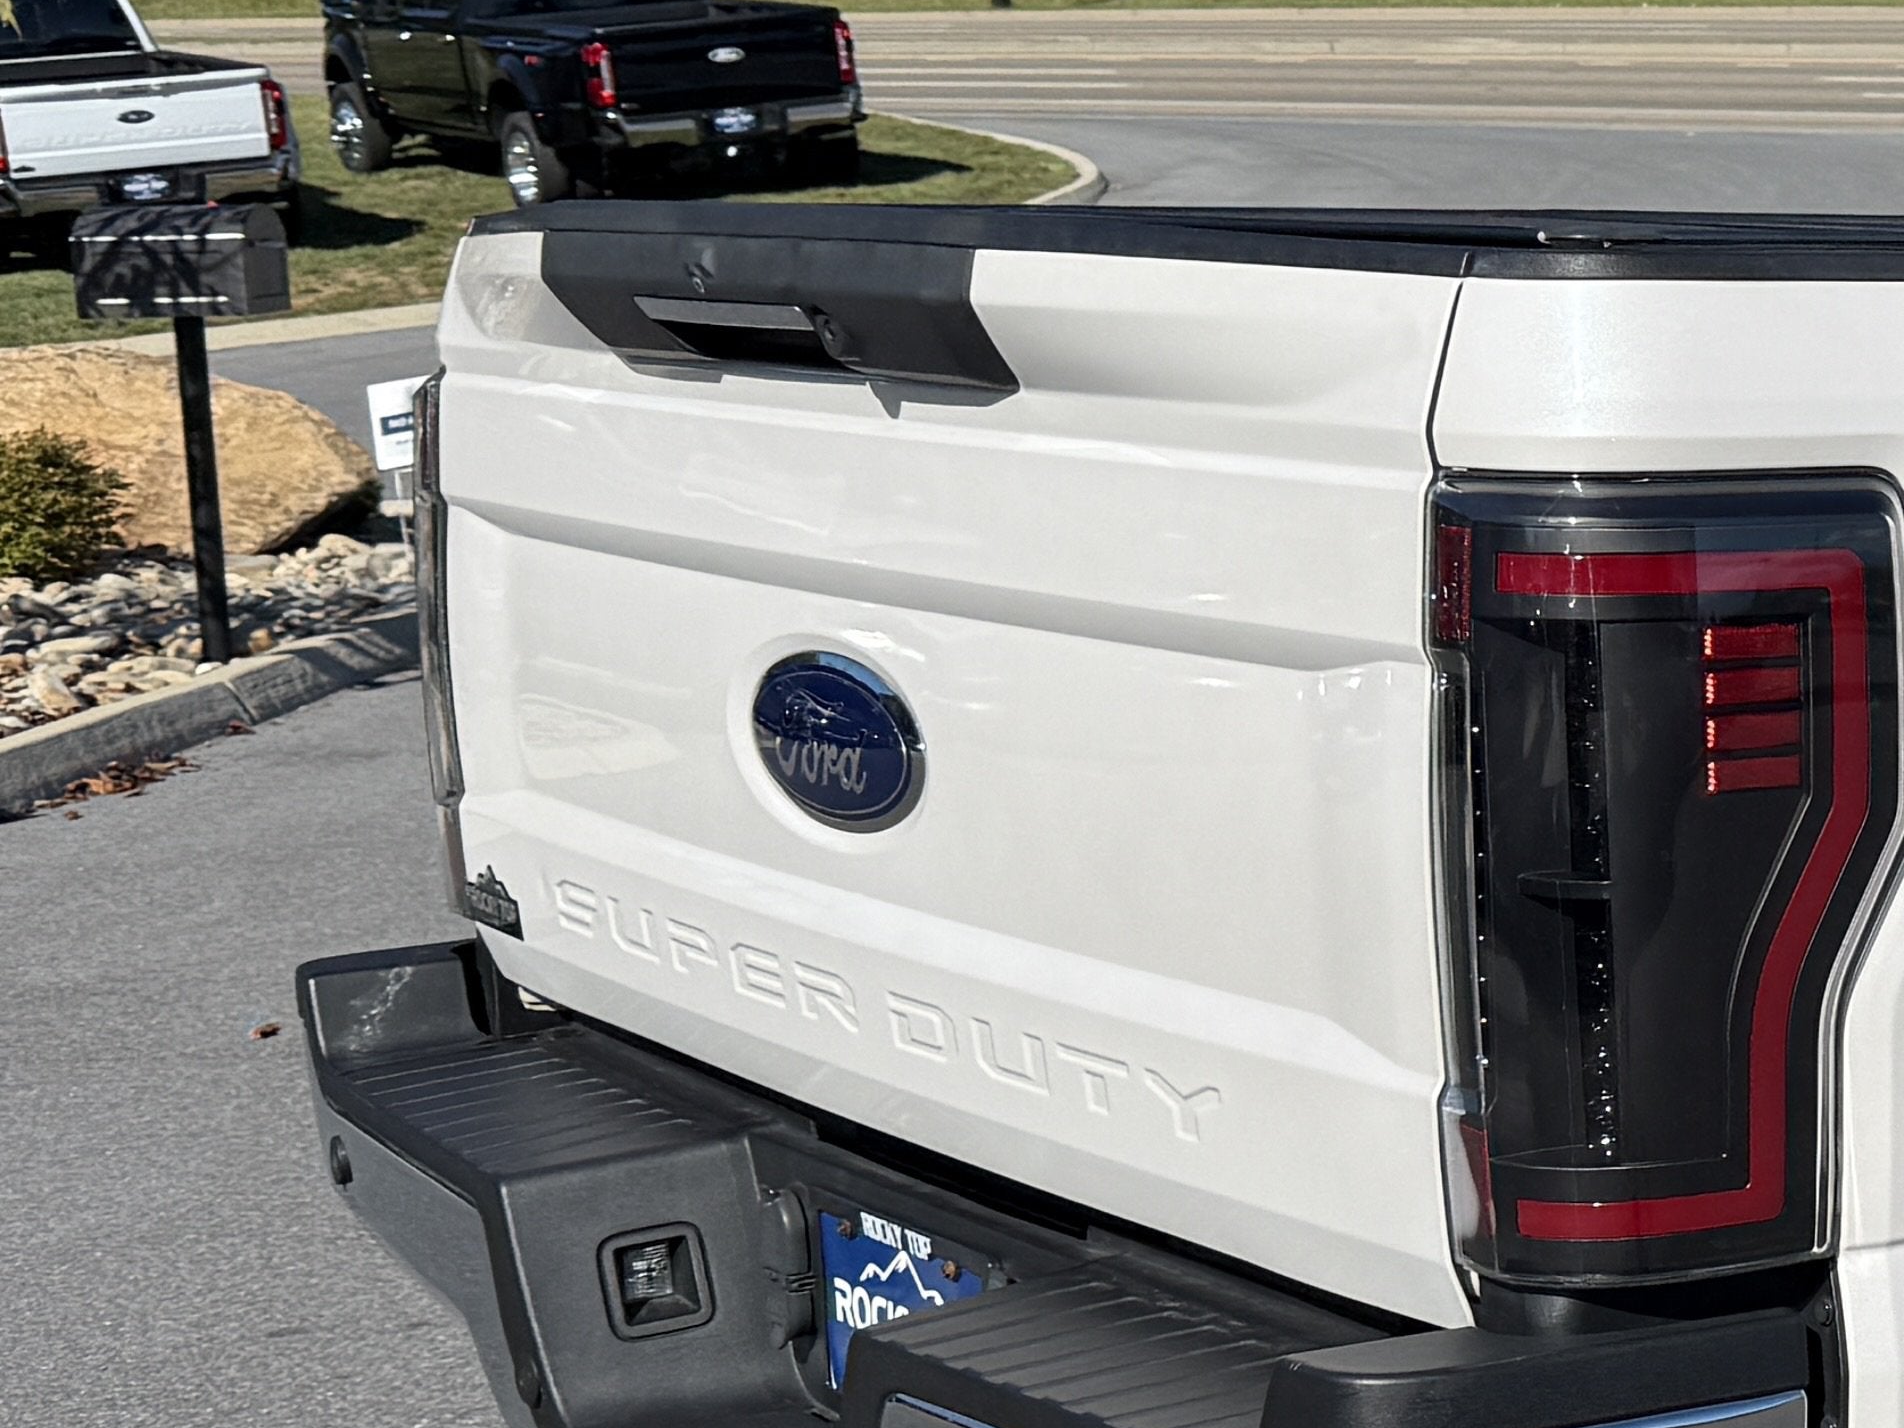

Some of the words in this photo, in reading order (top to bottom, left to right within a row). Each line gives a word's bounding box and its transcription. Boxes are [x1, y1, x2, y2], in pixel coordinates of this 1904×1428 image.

[776, 688, 867, 794] Ford
[554, 879, 859, 1033] SUPER
[886, 990, 1222, 1142] DUTY
[860, 1211, 904, 1250] ROCKY
[903, 1228, 933, 1261] TOP
